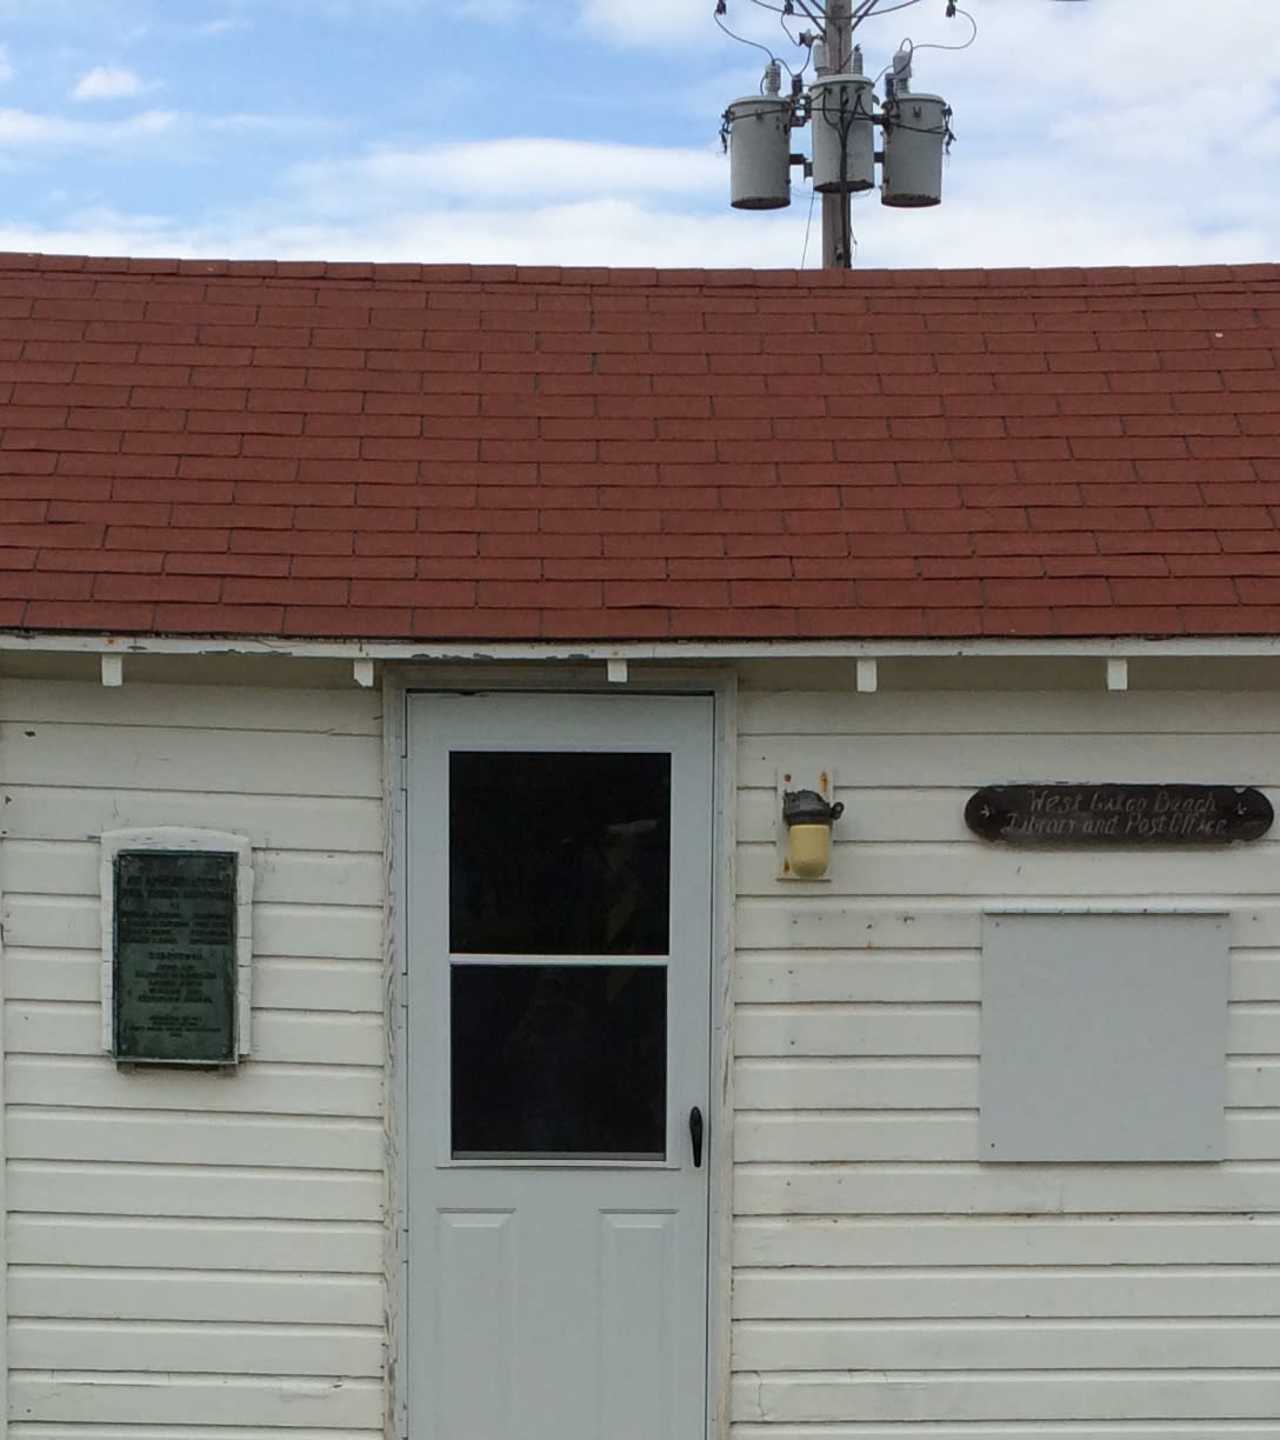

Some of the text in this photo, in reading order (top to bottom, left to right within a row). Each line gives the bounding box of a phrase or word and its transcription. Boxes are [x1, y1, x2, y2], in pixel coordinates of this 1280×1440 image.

[1027, 789, 1083, 813] West
[1081, 815, 1120, 835] and
[1125, 812, 1169, 836] Post
